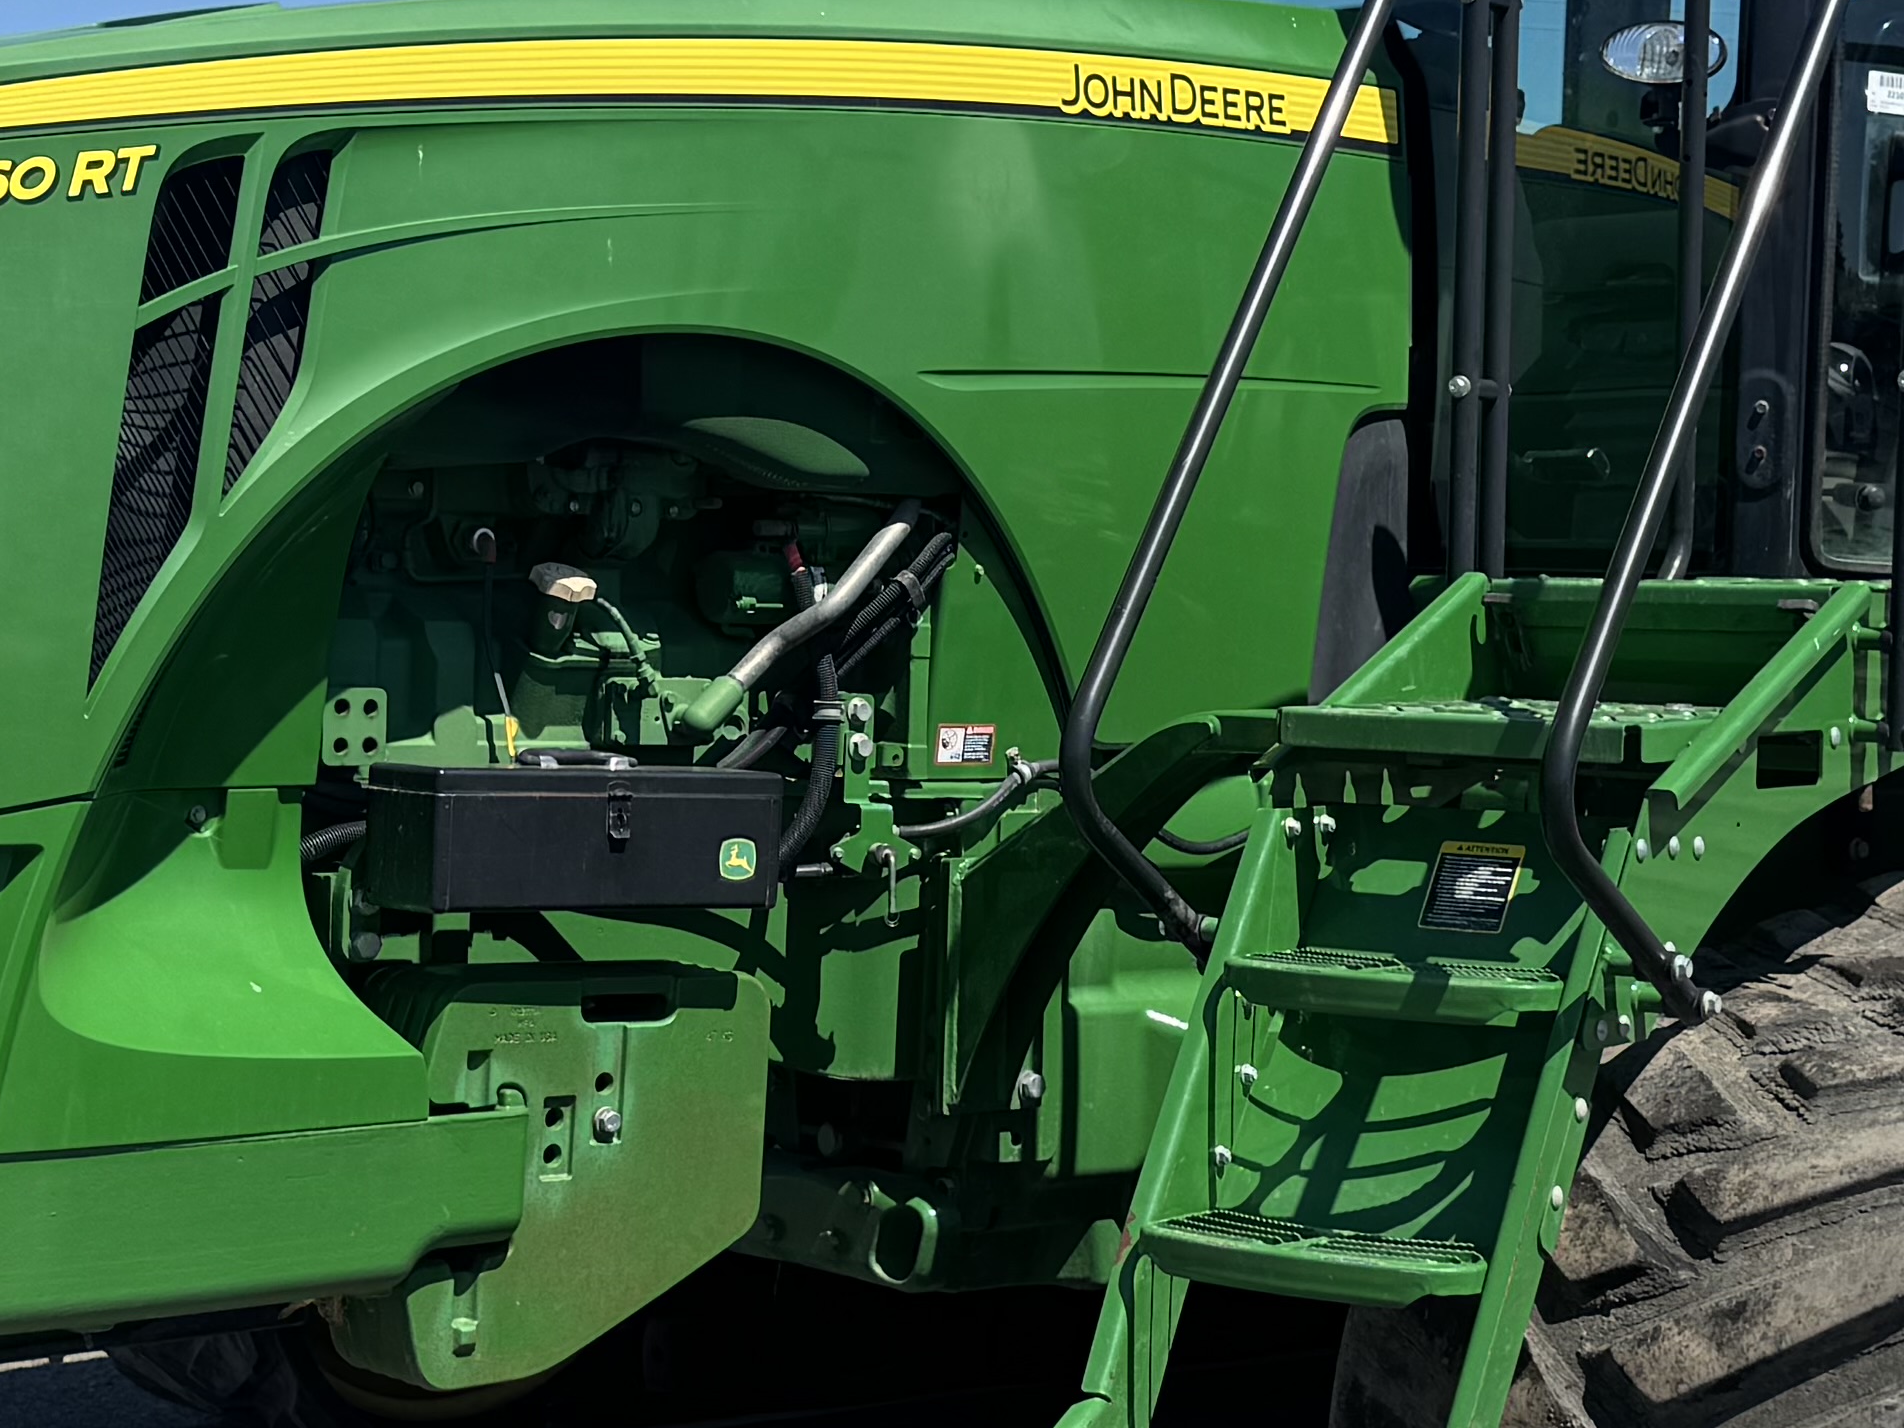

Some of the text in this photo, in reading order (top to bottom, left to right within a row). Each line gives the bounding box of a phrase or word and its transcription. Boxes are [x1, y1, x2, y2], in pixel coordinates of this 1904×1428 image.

[1061, 63, 1287, 126] JOHN DEERE
[67, 144, 158, 198] RT
[1465, 844, 1509, 855] ATTENTION
